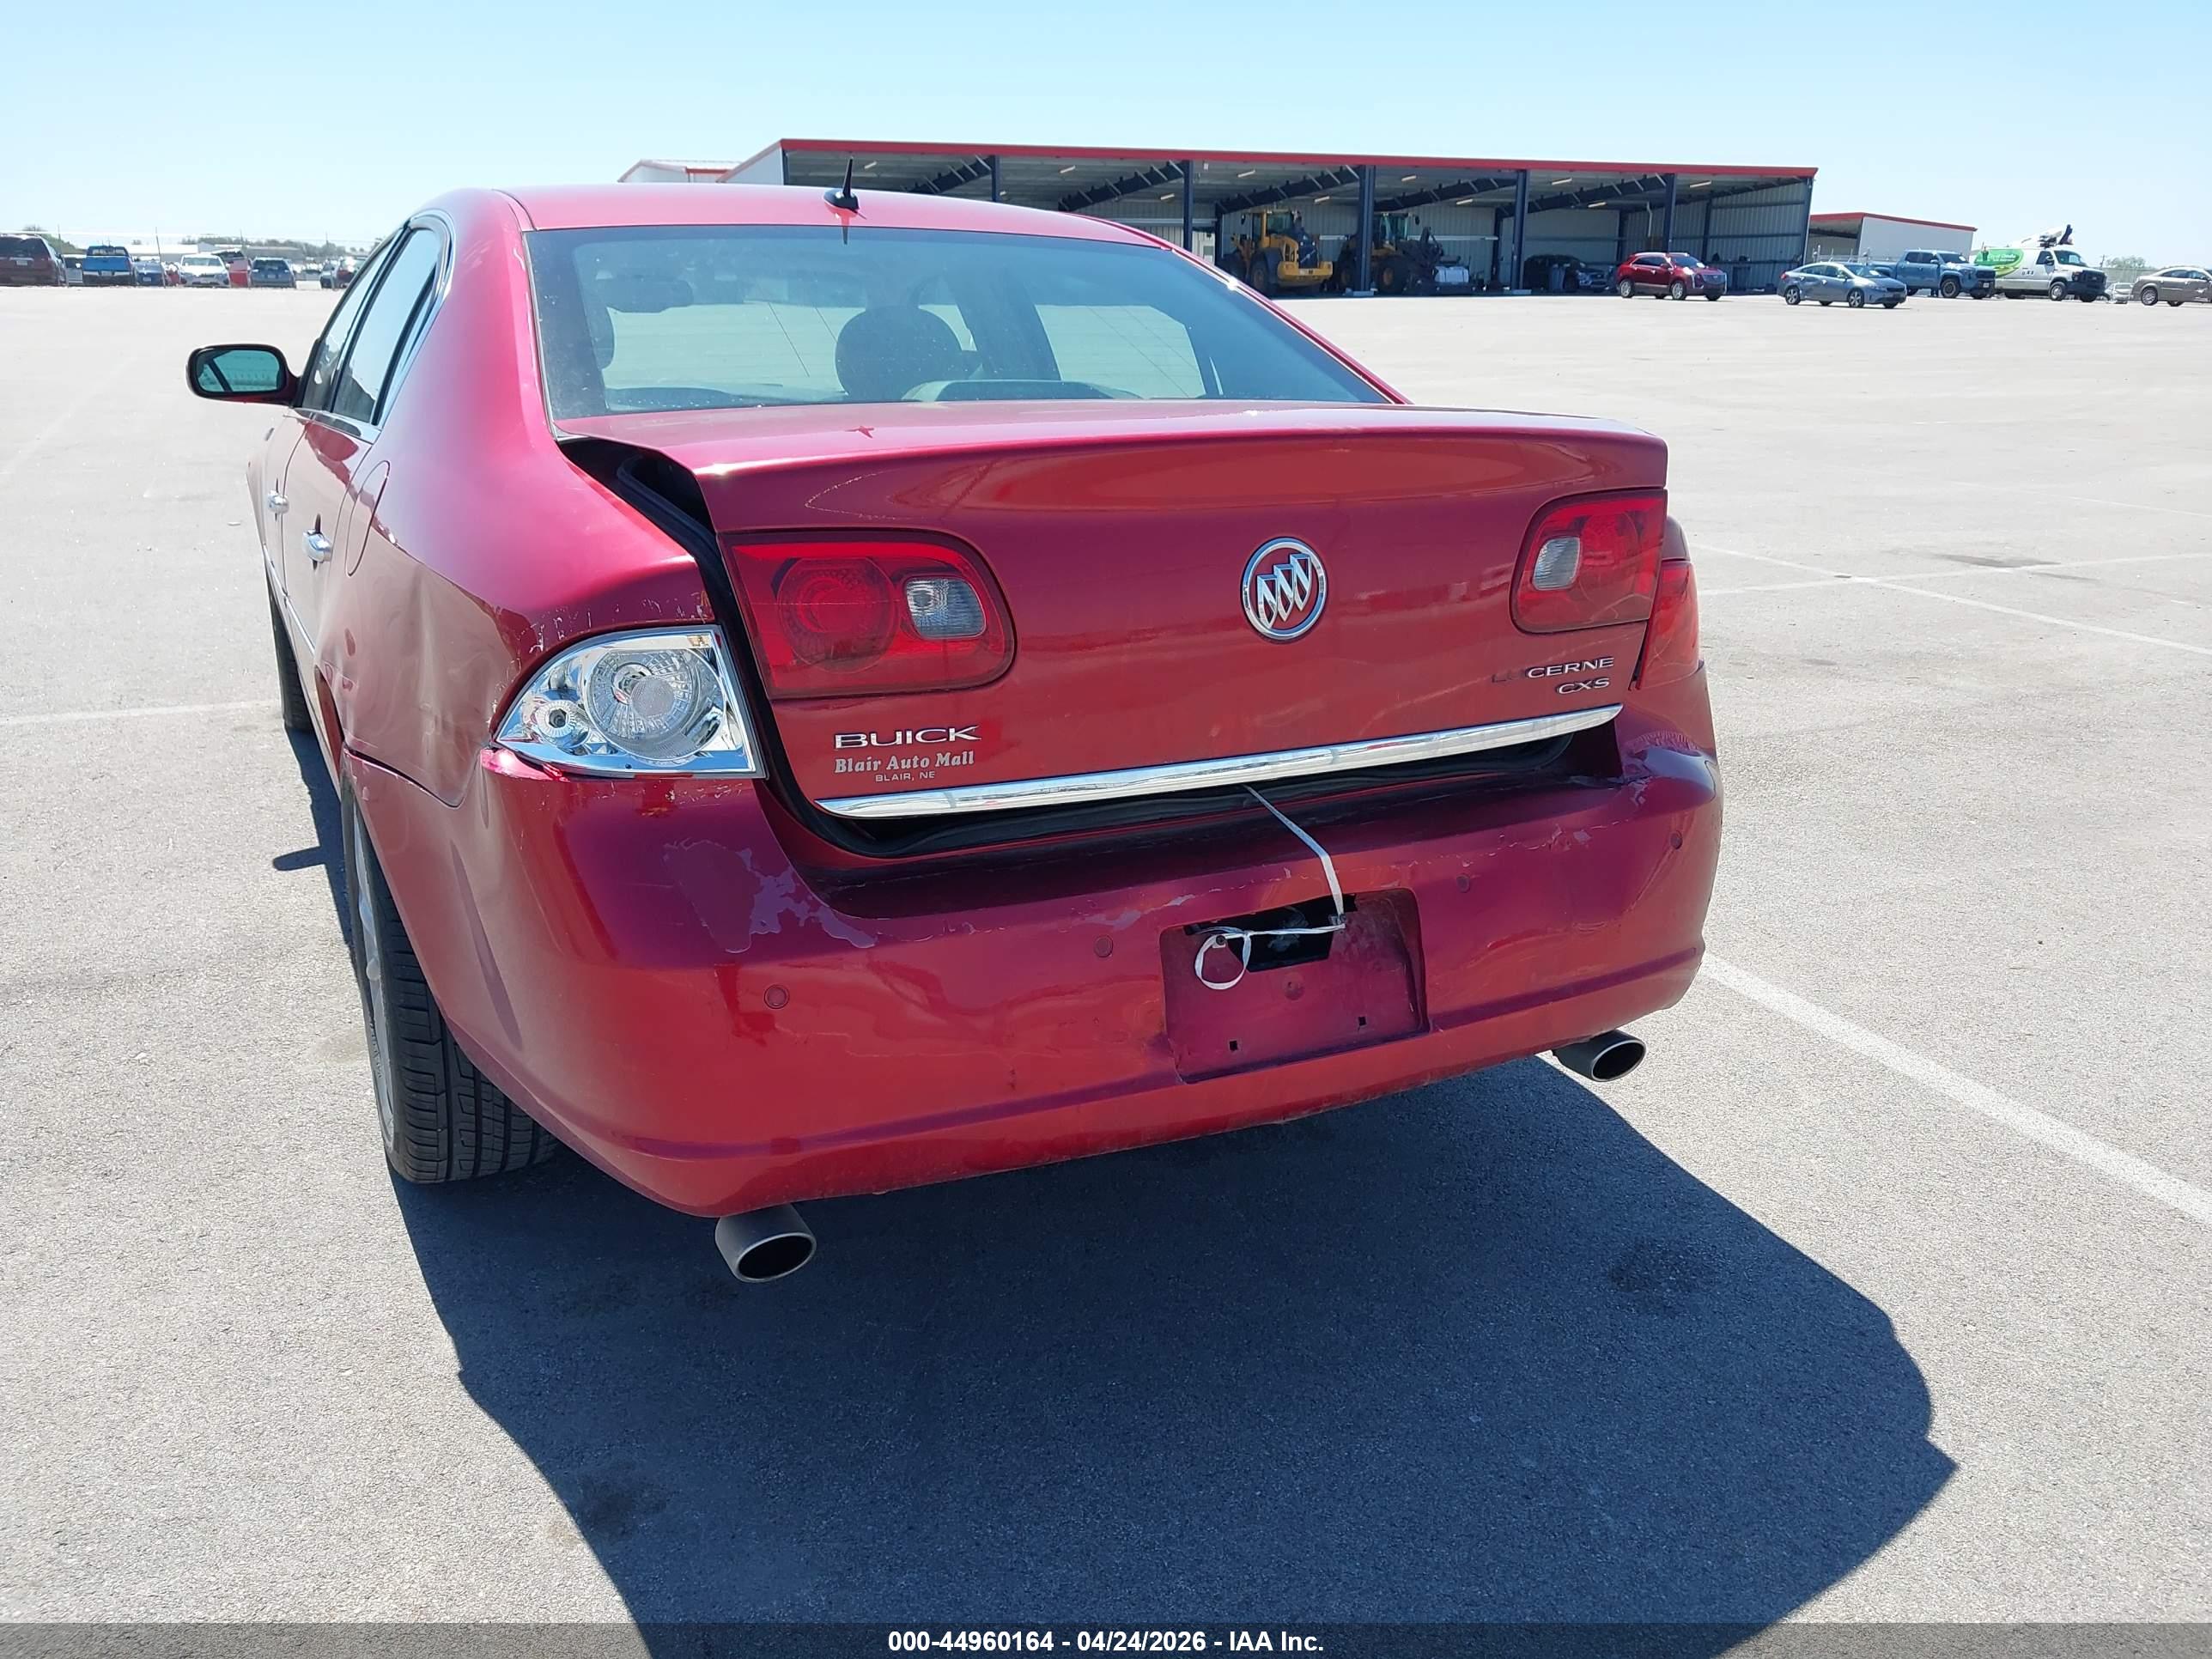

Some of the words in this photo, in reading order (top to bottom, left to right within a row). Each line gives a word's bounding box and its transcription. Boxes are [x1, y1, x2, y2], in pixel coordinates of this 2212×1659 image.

[1557, 677, 1610, 695] CXS
[835, 725, 981, 749] BUICK
[835, 756, 881, 773] Blair
[886, 755, 930, 770] Auto
[935, 750, 975, 767] Mall
[875, 773, 915, 782] BLAIR,
[919, 770, 935, 780] NE
